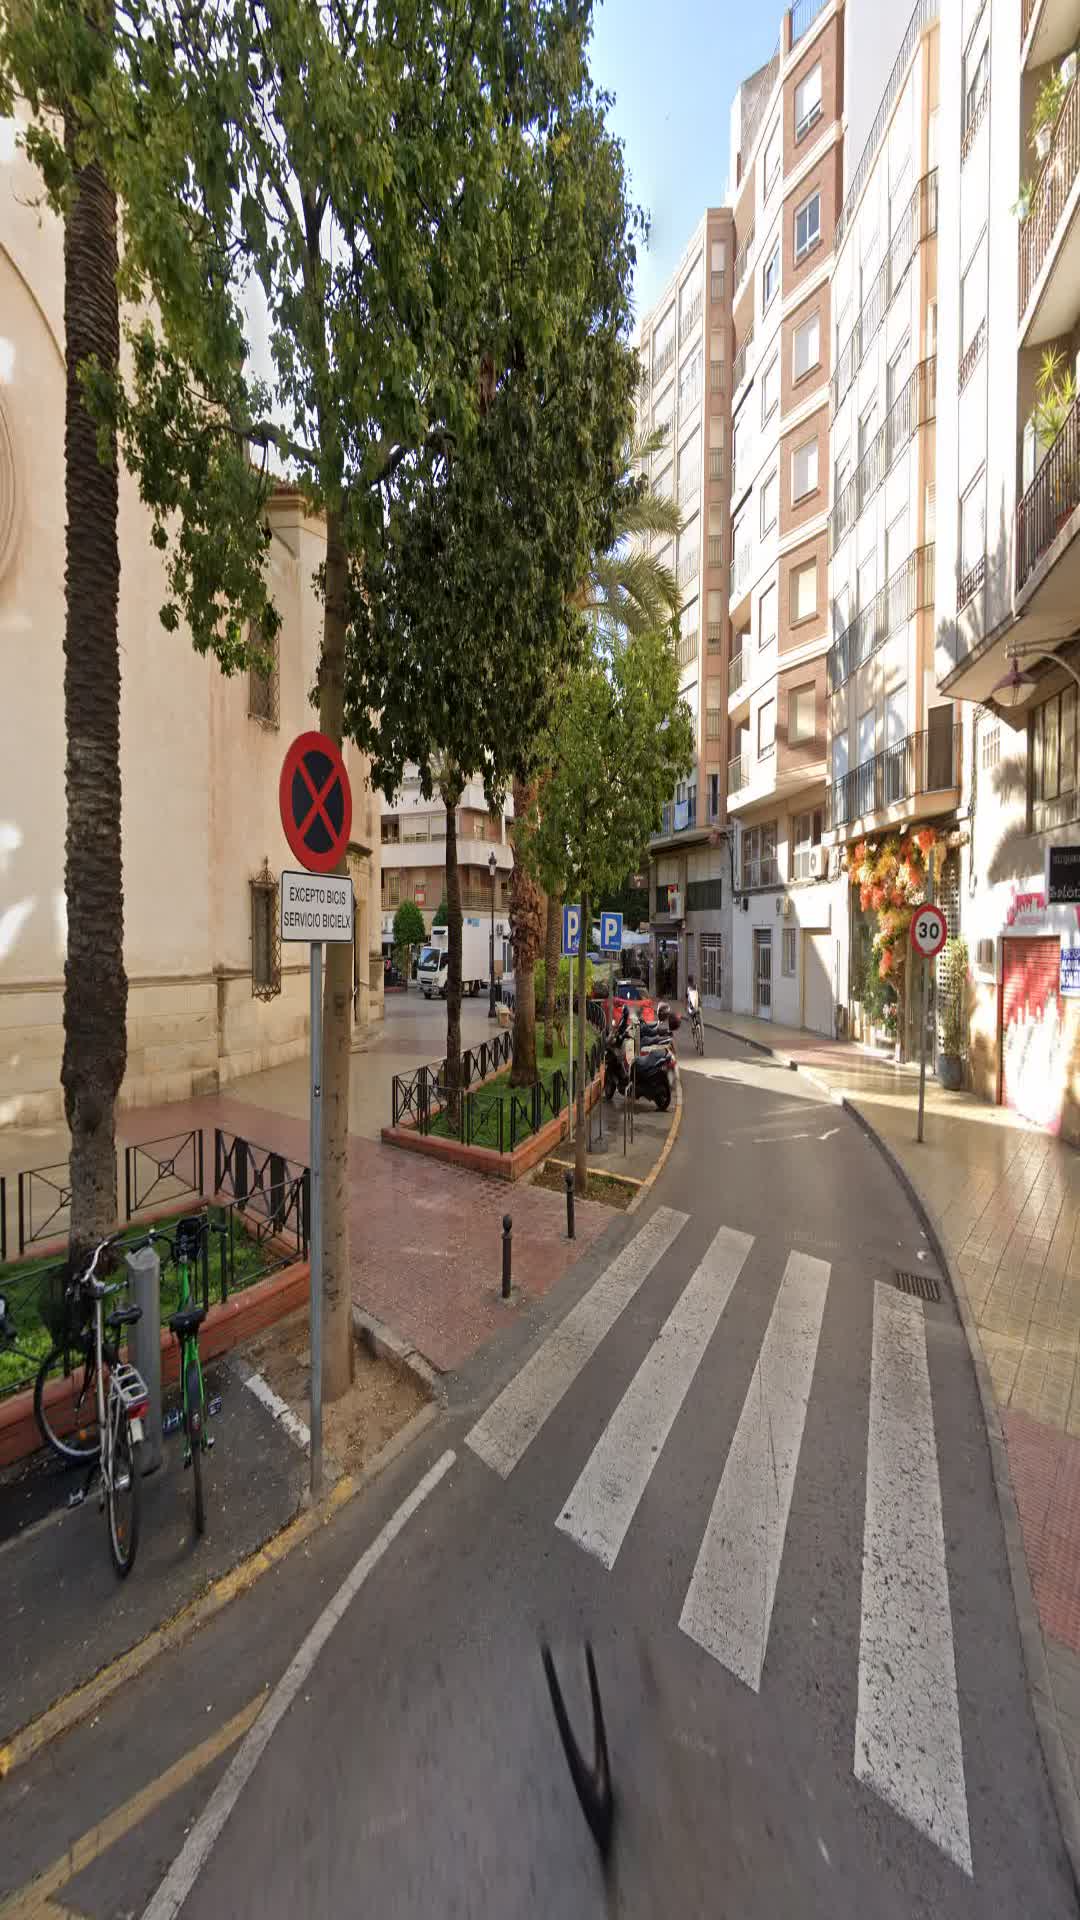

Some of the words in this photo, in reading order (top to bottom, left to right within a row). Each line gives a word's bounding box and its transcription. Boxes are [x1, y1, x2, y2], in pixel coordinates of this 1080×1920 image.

[289, 886, 325, 904] EXCEPTO
[326, 890, 346, 905] BICIS
[284, 911, 321, 928] SERVICIO
[322, 913, 351, 929] BICIELX
[567, 911, 579, 949] P
[605, 917, 618, 945] P
[919, 922, 940, 940] 30
